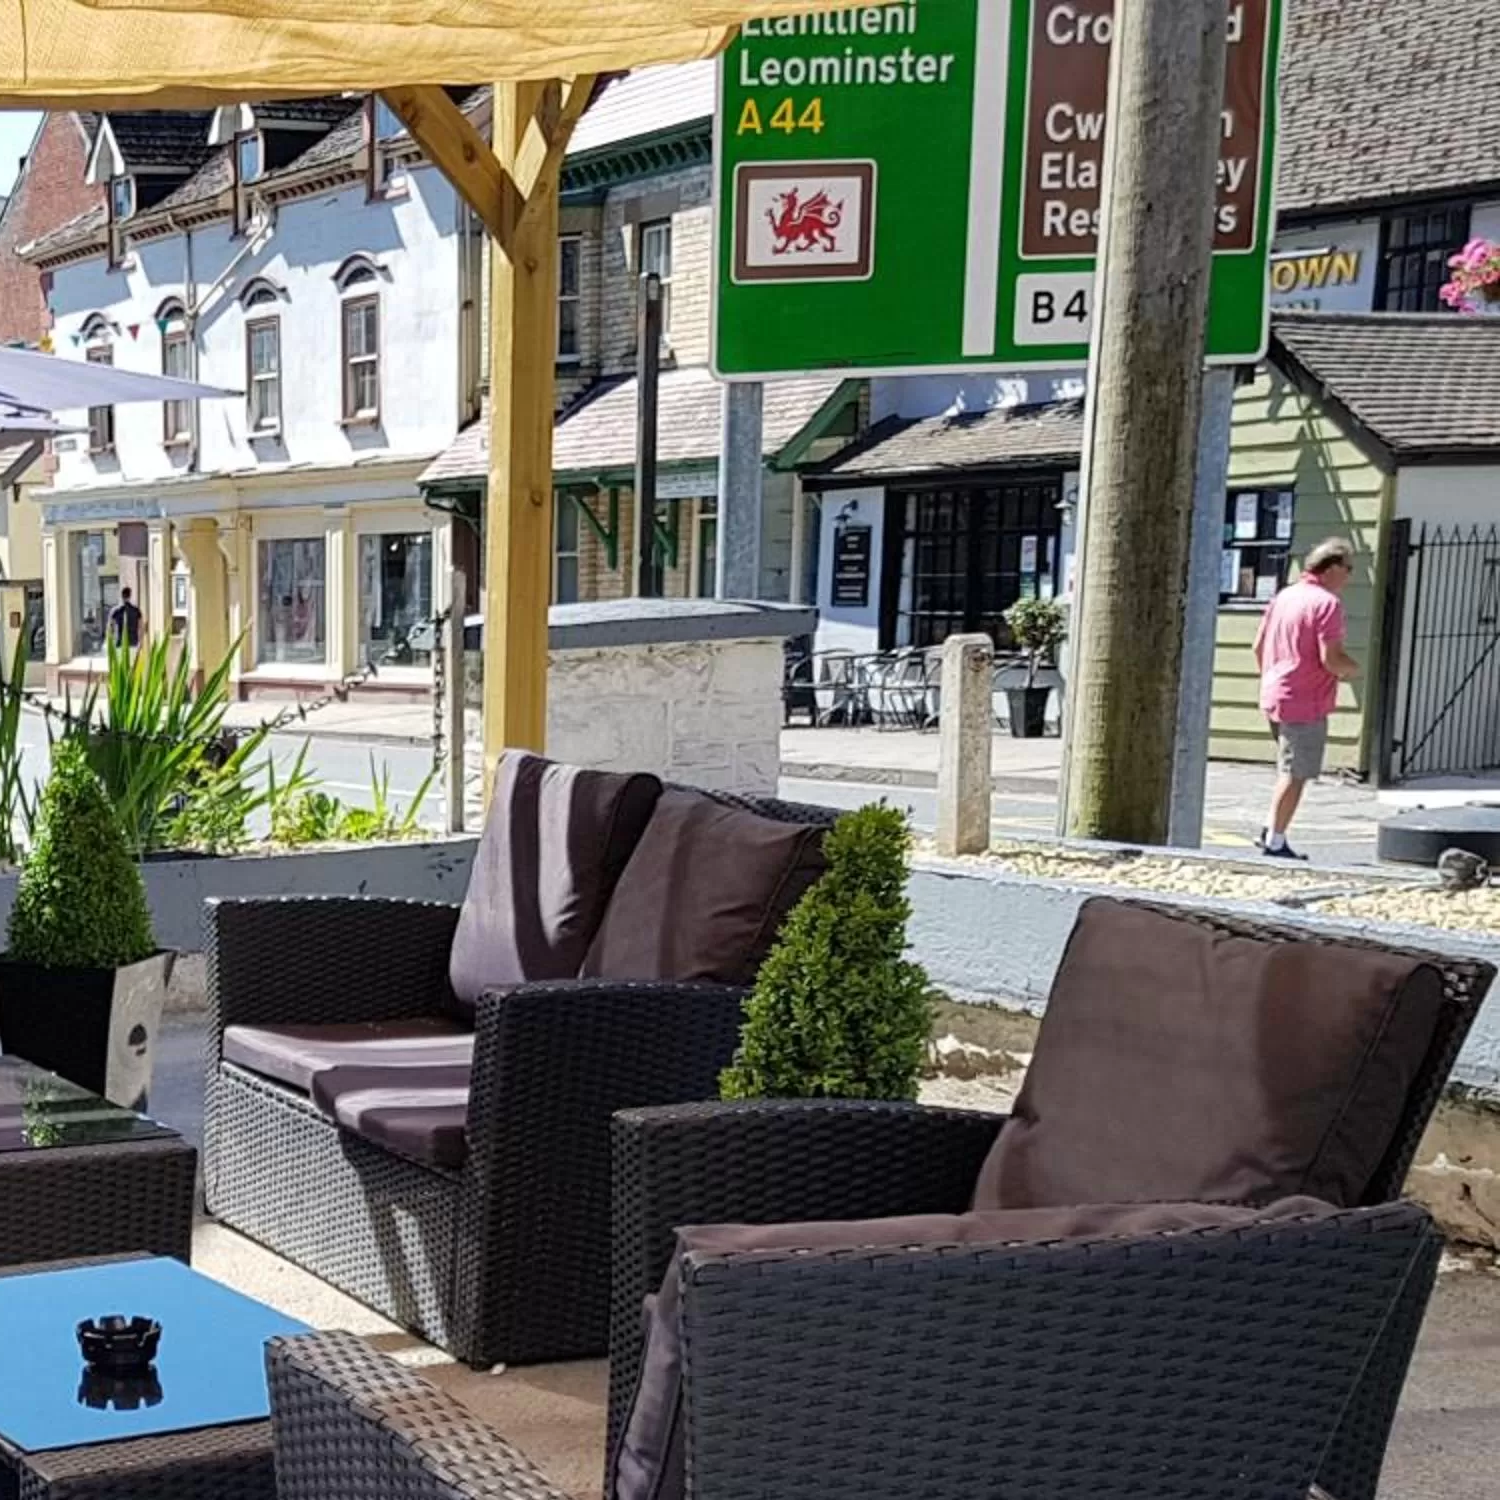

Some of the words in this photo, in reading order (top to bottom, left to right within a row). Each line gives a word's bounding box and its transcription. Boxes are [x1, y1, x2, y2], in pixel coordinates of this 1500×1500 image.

[739, 47, 954, 86] Leominster
[1040, 152, 1098, 189] Ela
[1273, 252, 1360, 293] OWN
